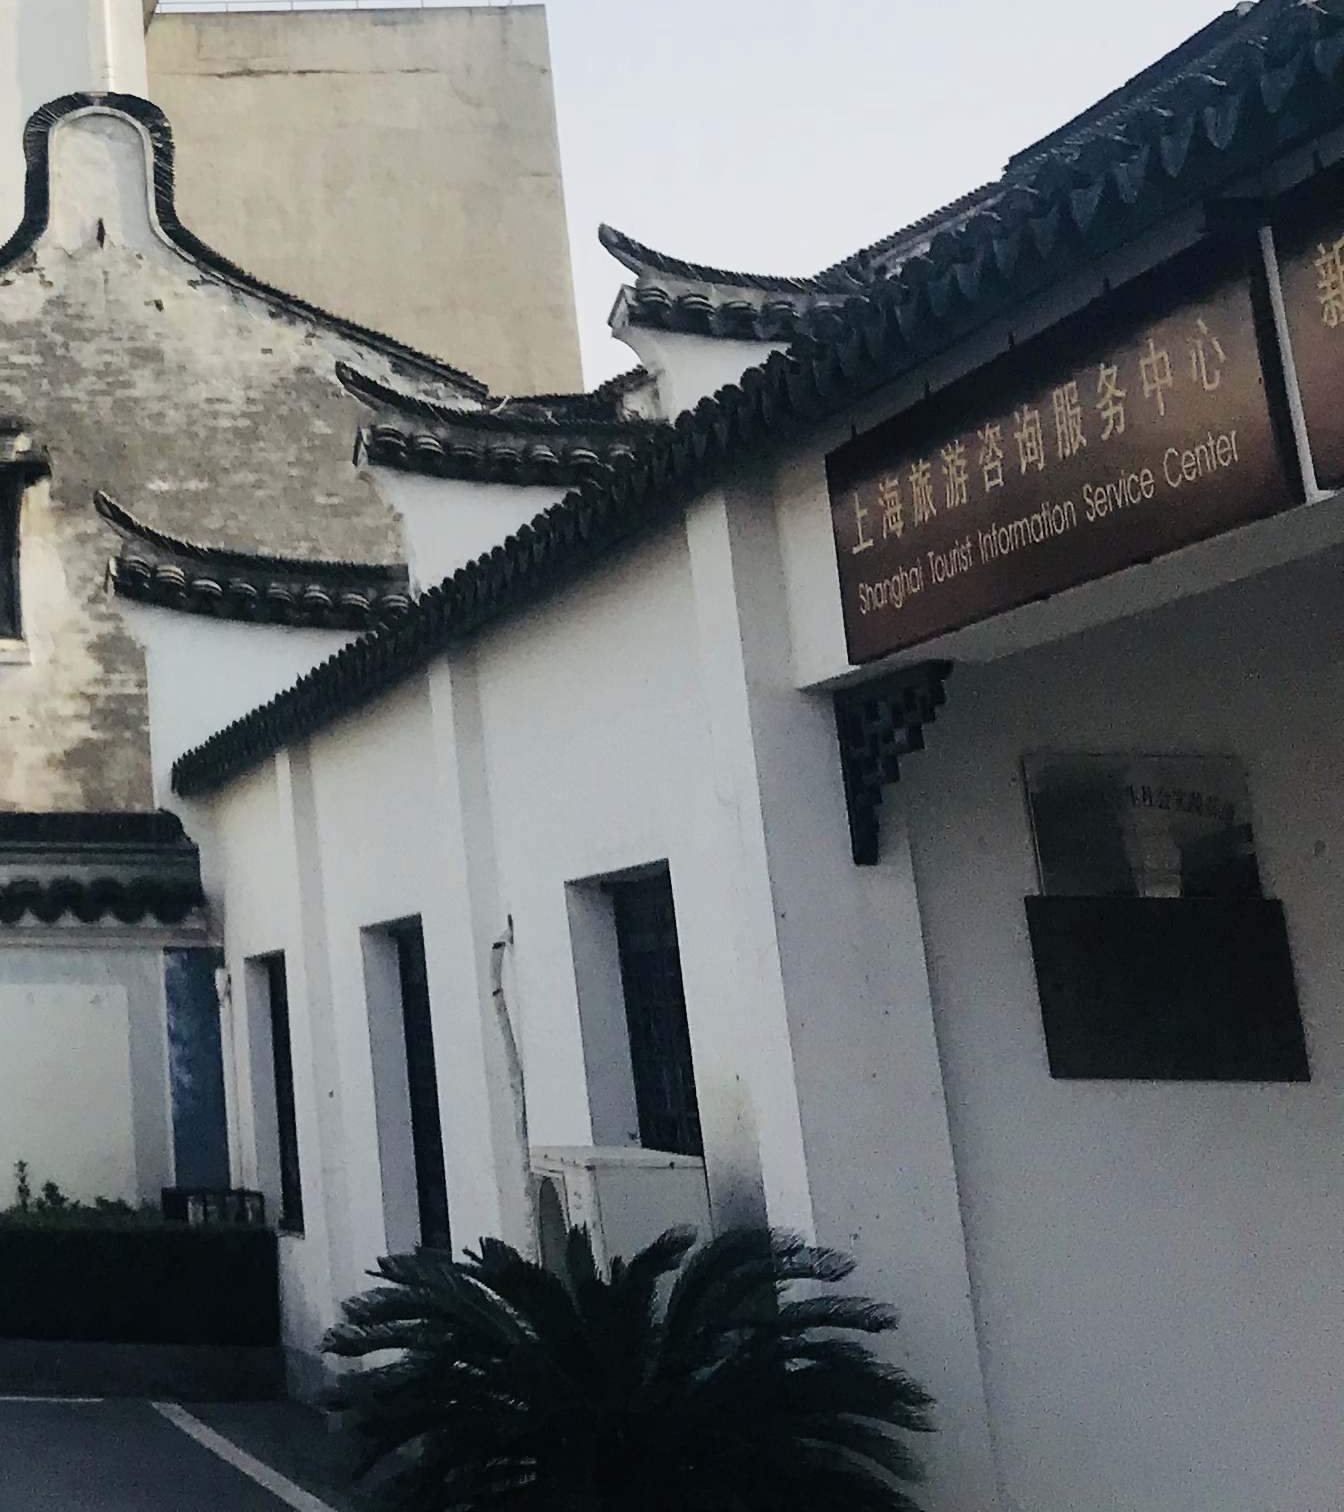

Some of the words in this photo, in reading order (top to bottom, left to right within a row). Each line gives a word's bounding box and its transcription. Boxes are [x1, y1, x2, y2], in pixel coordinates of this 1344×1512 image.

[852, 317, 1226, 555] 上海旅游咨询服务中心
[858, 557, 925, 615] Shanghai
[927, 535, 974, 585] Tourist
[977, 498, 1078, 564] Information
[1082, 468, 1156, 523] Service
[1162, 429, 1239, 489] Center
